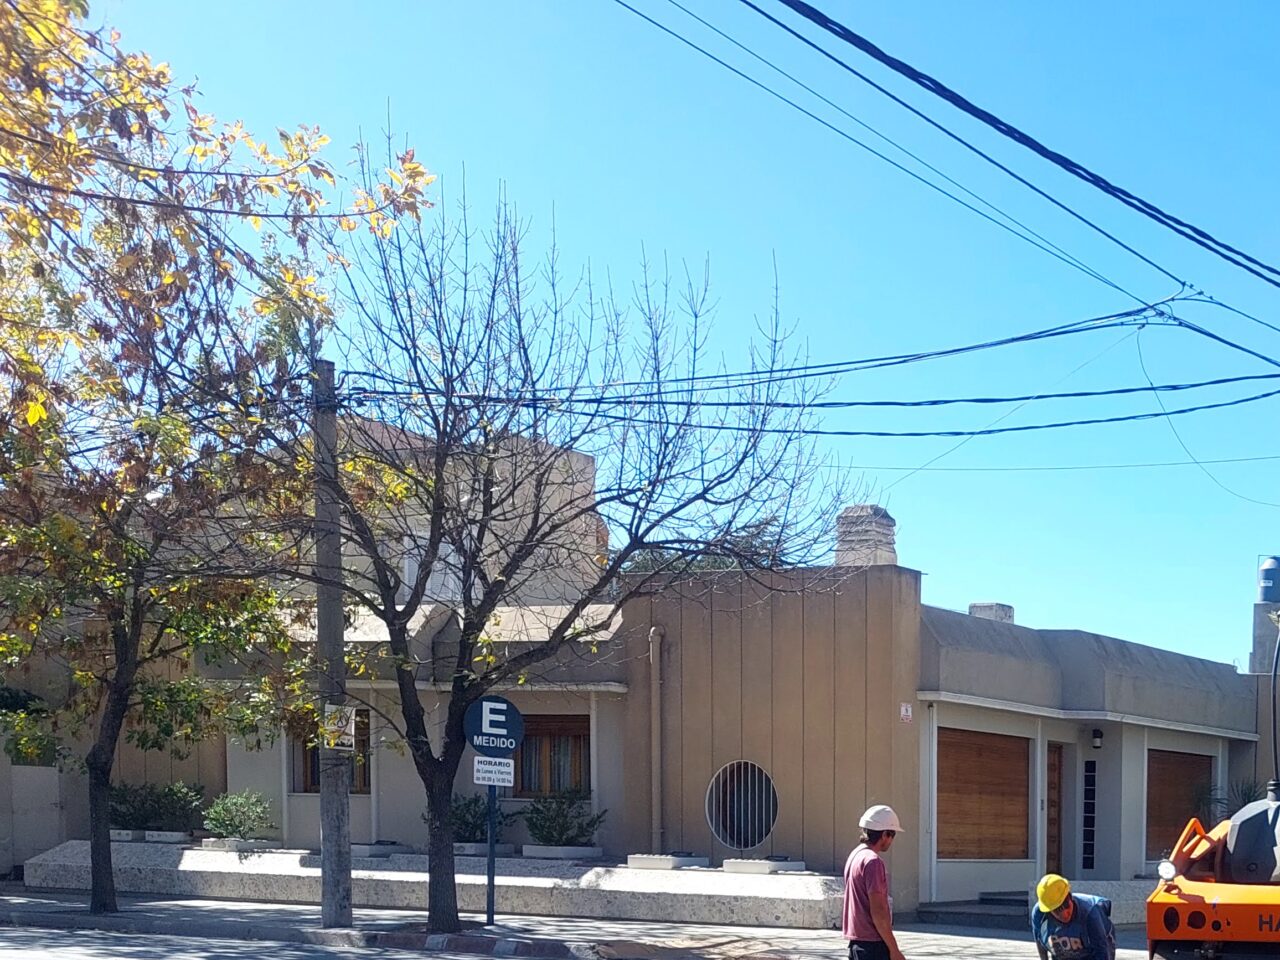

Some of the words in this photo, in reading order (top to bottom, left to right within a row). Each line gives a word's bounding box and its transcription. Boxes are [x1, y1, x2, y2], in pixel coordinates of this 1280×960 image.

[482, 701, 507, 735] E
[473, 735, 516, 749] MEDIDO
[477, 759, 511, 768] HORARIO
